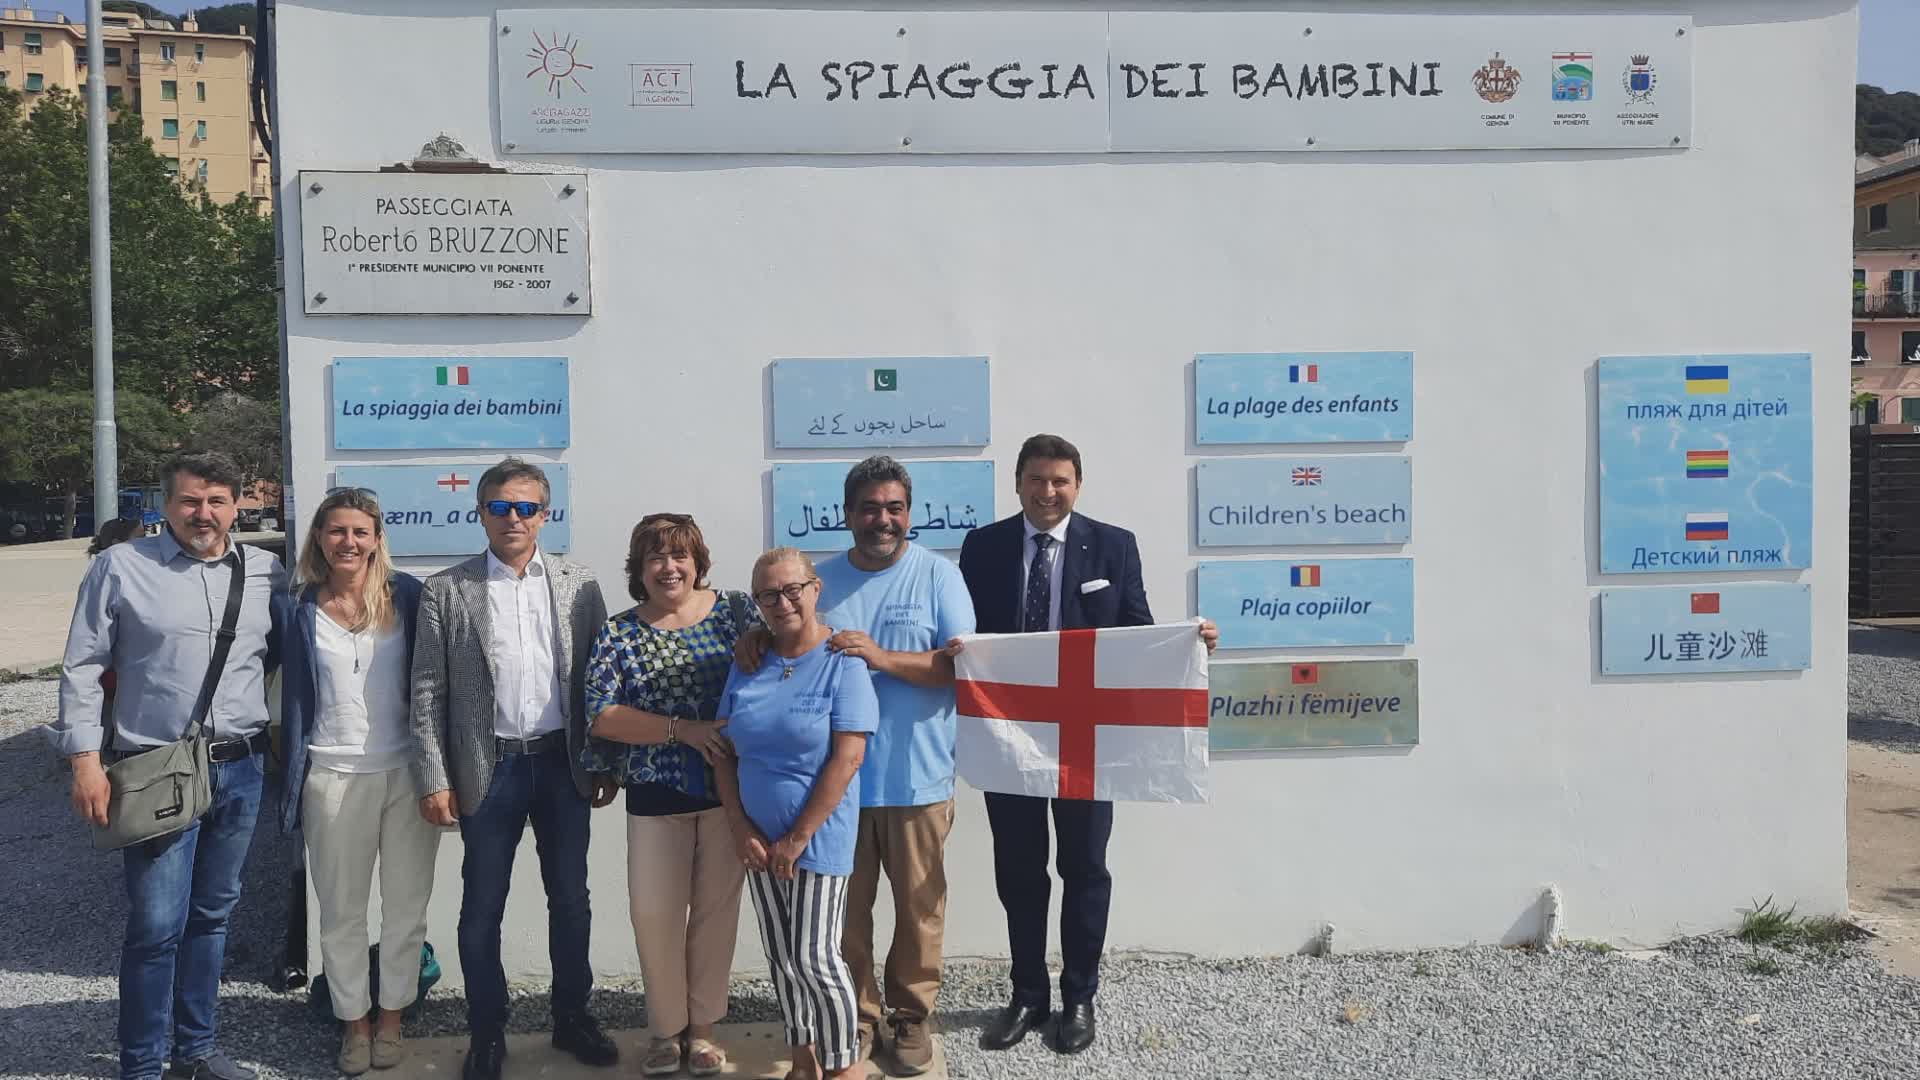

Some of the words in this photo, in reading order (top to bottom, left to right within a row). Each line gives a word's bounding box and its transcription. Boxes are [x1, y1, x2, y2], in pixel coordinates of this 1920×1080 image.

[642, 71, 681, 88] ACT
[735, 59, 797, 100] LA
[820, 58, 1095, 102] SPIAGGIA
[1118, 61, 1209, 99] DEI
[1231, 60, 1443, 100] BAMBINI
[376, 198, 513, 216] PASSEGGIATA
[429, 226, 569, 254] BRUZZONE
[359, 263, 419, 273] PRESIDENTE
[423, 263, 476, 274] MUNICIPIO
[480, 264, 494, 273] VII
[497, 264, 545, 274] PONENTE
[493, 279, 515, 289] 1962
[526, 279, 551, 290] 2007
[342, 400, 364, 417] La
[369, 401, 449, 420] spiaggia
[454, 400, 481, 416] dei
[486, 399, 562, 416] bambini
[1207, 397, 1229, 415] La
[1233, 396, 1288, 419] plage
[1292, 396, 1323, 414] des
[1328, 394, 1399, 413] enfants
[1627, 404, 1682, 419] пляж
[1688, 402, 1726, 420] для
[1733, 398, 1788, 420] дітей
[1208, 504, 1327, 526] Children's
[1334, 503, 1406, 524] beach
[1632, 545, 1720, 569] Детский
[1727, 548, 1783, 563] пляж
[1240, 597, 1290, 621] Plaja
[1296, 596, 1372, 620] copiilor
[1644, 629, 1769, 662] 儿童沙滩
[1210, 695, 1283, 717] Plazhi
[1288, 694, 1296, 714] i
[1301, 693, 1401, 719] fëmijeve
